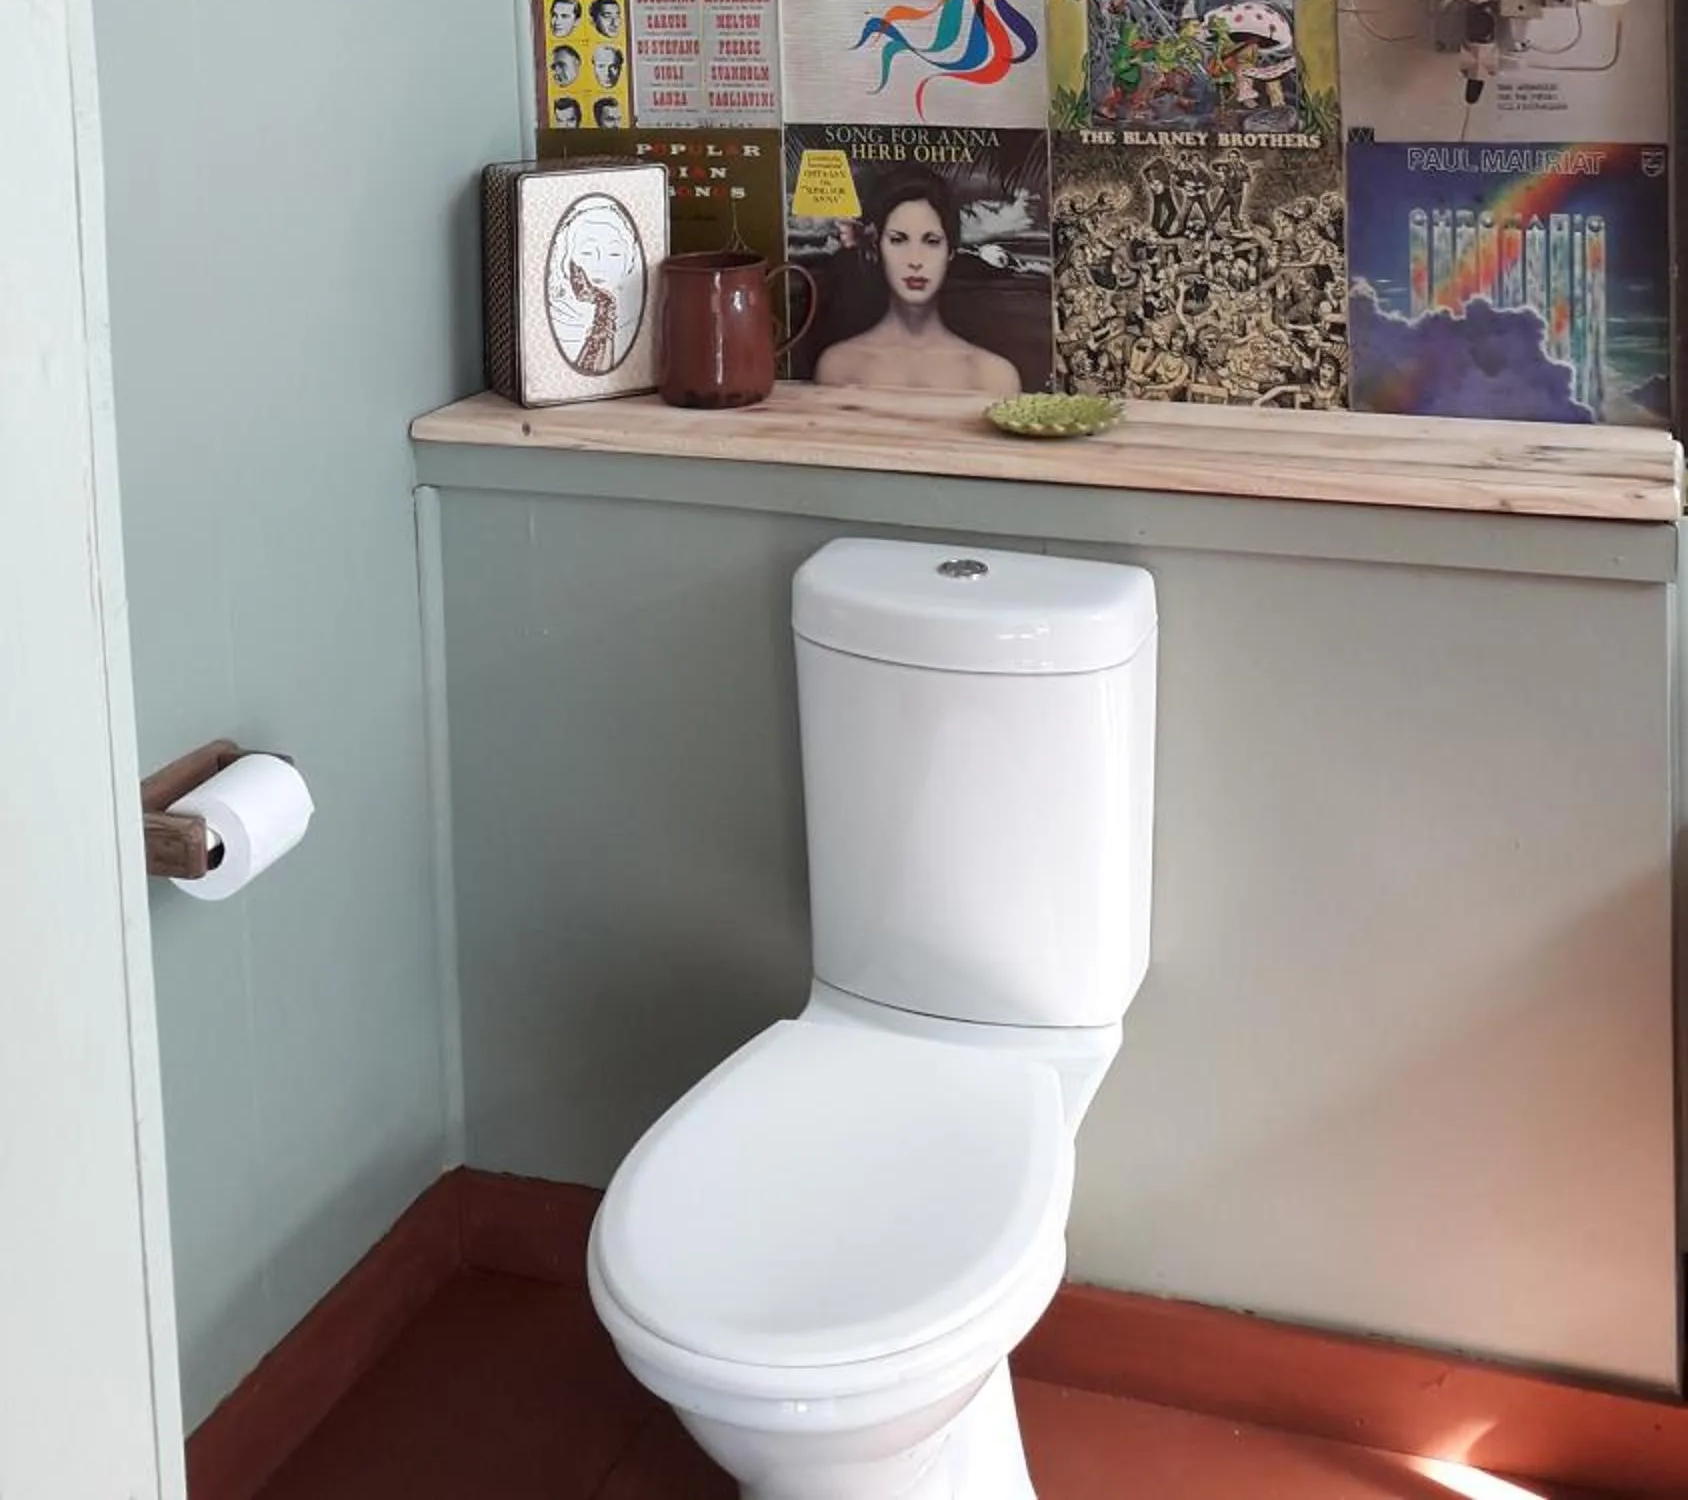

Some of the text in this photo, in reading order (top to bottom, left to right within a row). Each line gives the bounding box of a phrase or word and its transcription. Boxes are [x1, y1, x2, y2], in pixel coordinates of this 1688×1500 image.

[825, 125, 1000, 147] SONG FOR ANNA
[1079, 130, 1321, 149] THE BLARNEY BROTHERS
[851, 143, 975, 163] HERB OHTA
[1407, 147, 1606, 175] PAUL MAURIAT
